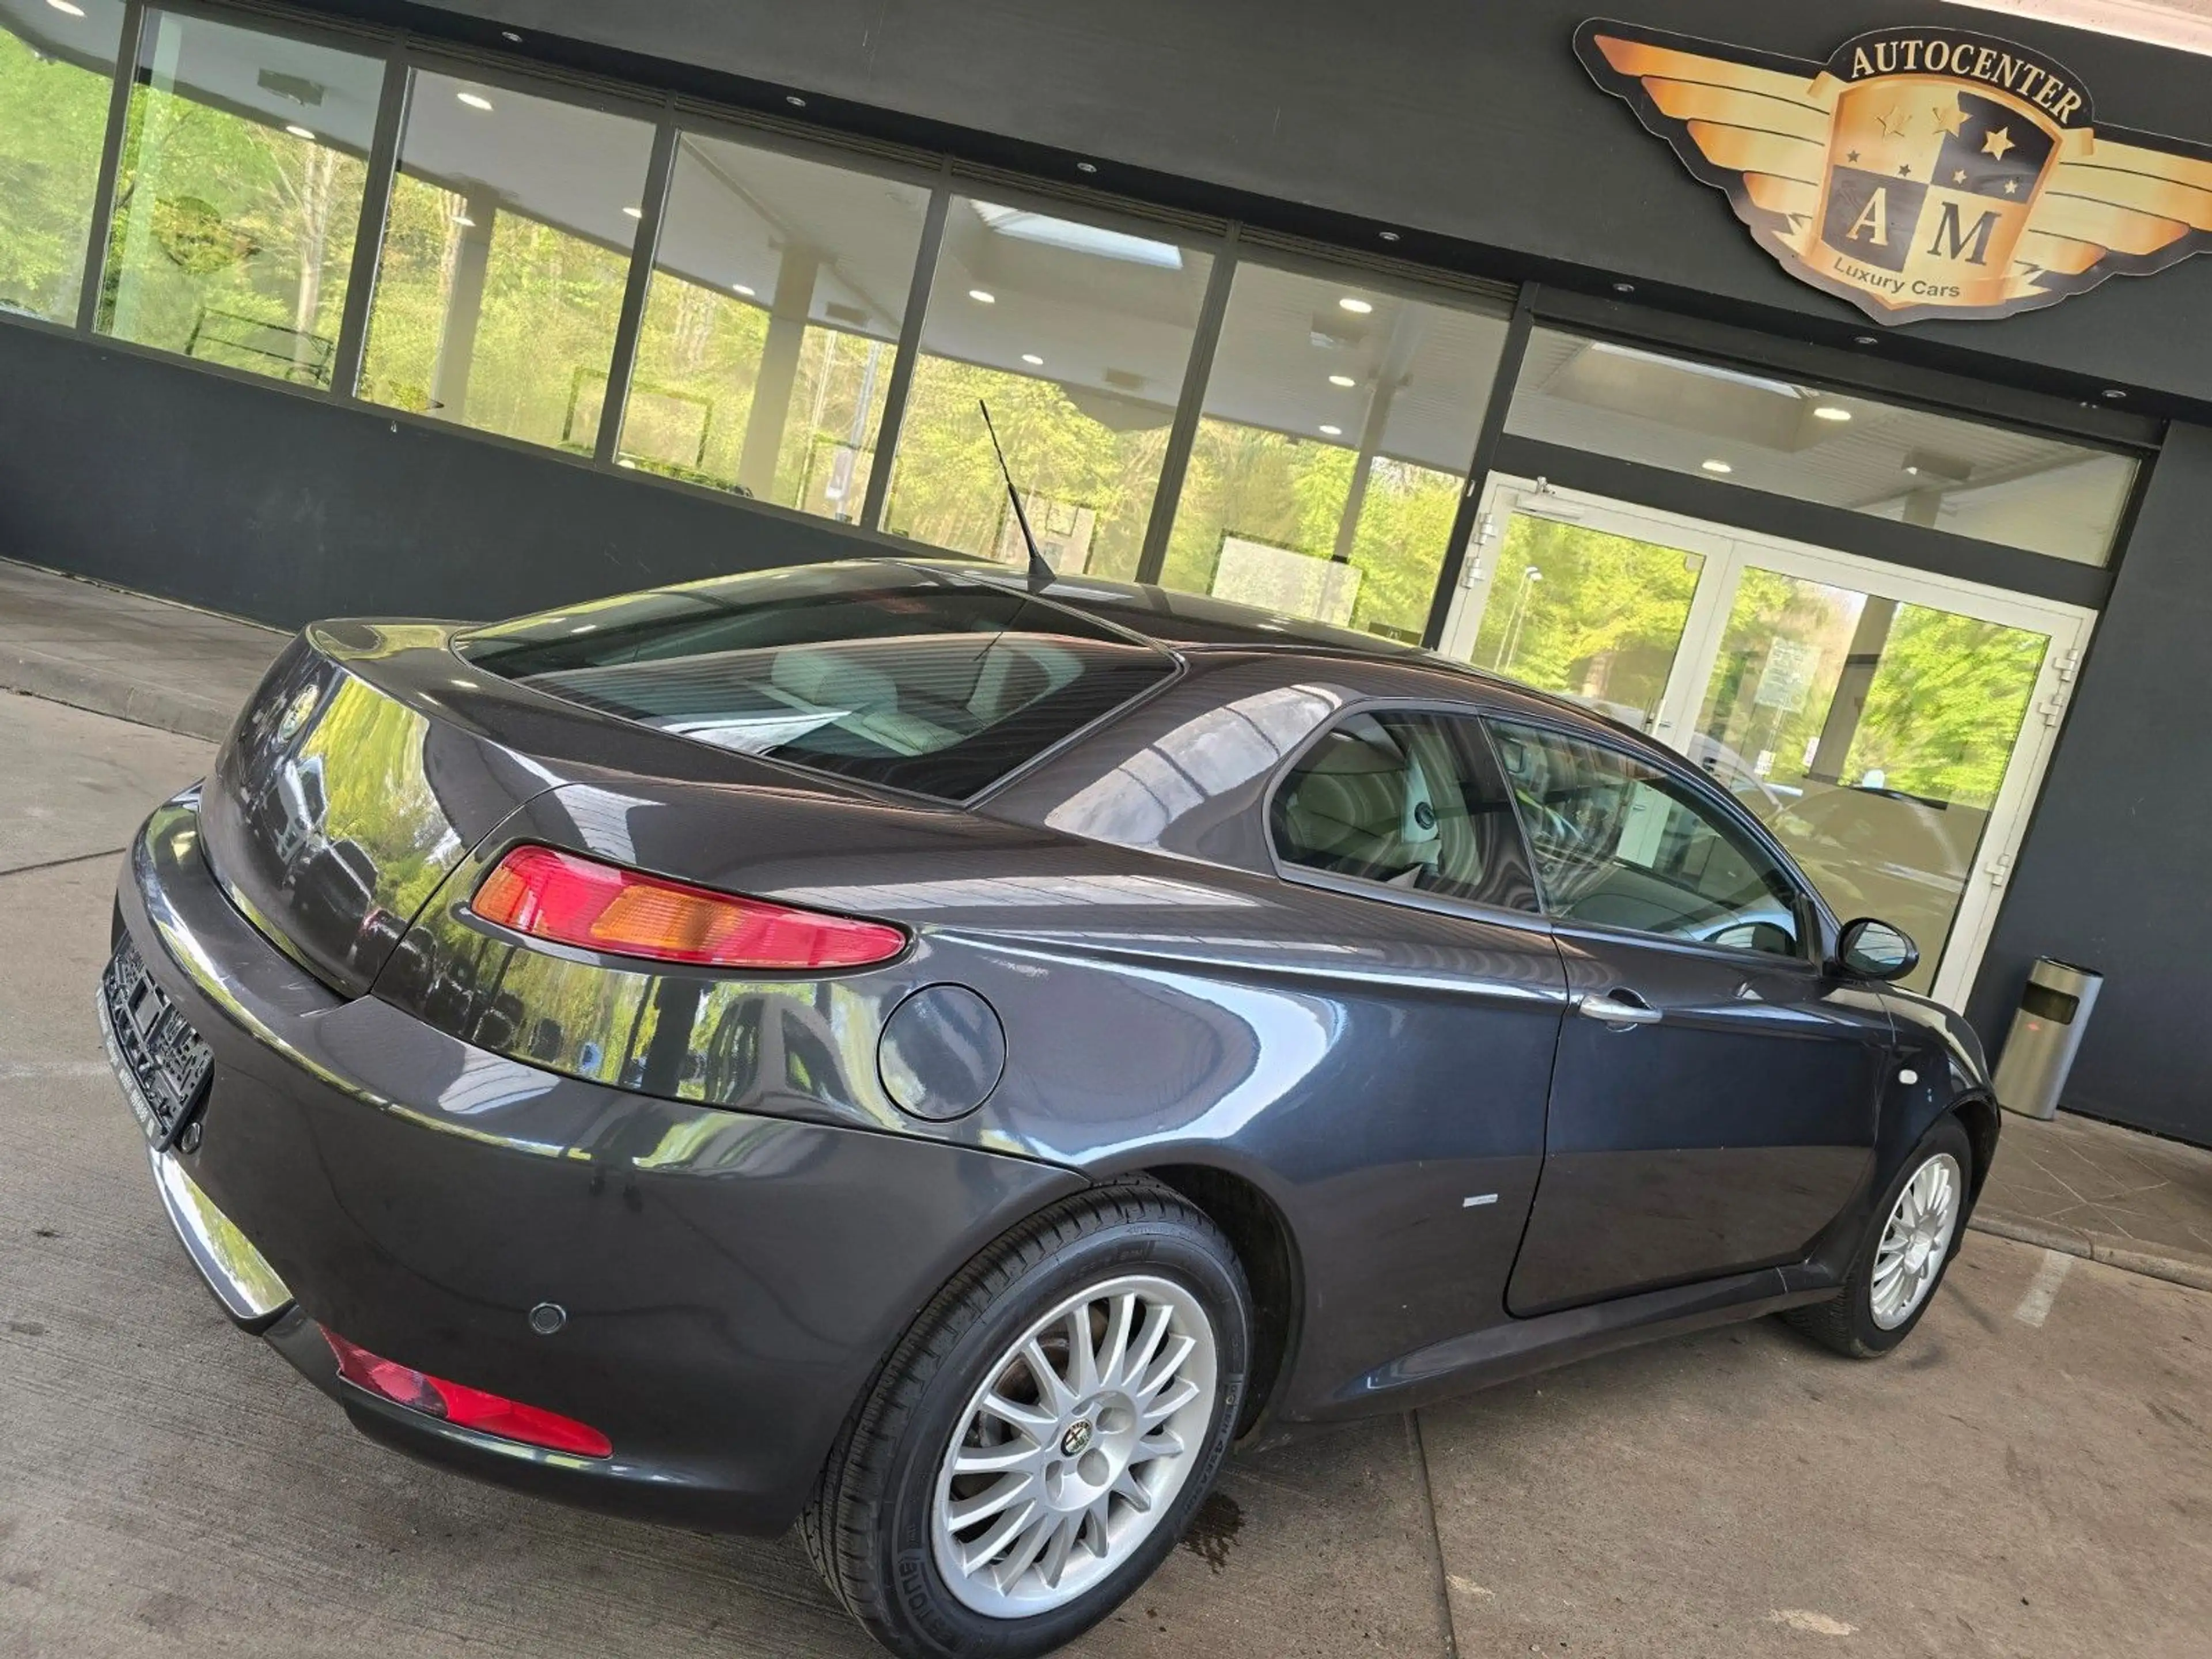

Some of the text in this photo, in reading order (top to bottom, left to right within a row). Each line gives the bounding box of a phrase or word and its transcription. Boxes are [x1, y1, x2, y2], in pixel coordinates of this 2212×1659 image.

[1851, 40, 2081, 124] AUTOCENTER
[1846, 187, 2002, 266] A M
[1834, 257, 1960, 297] Luxury Cars
